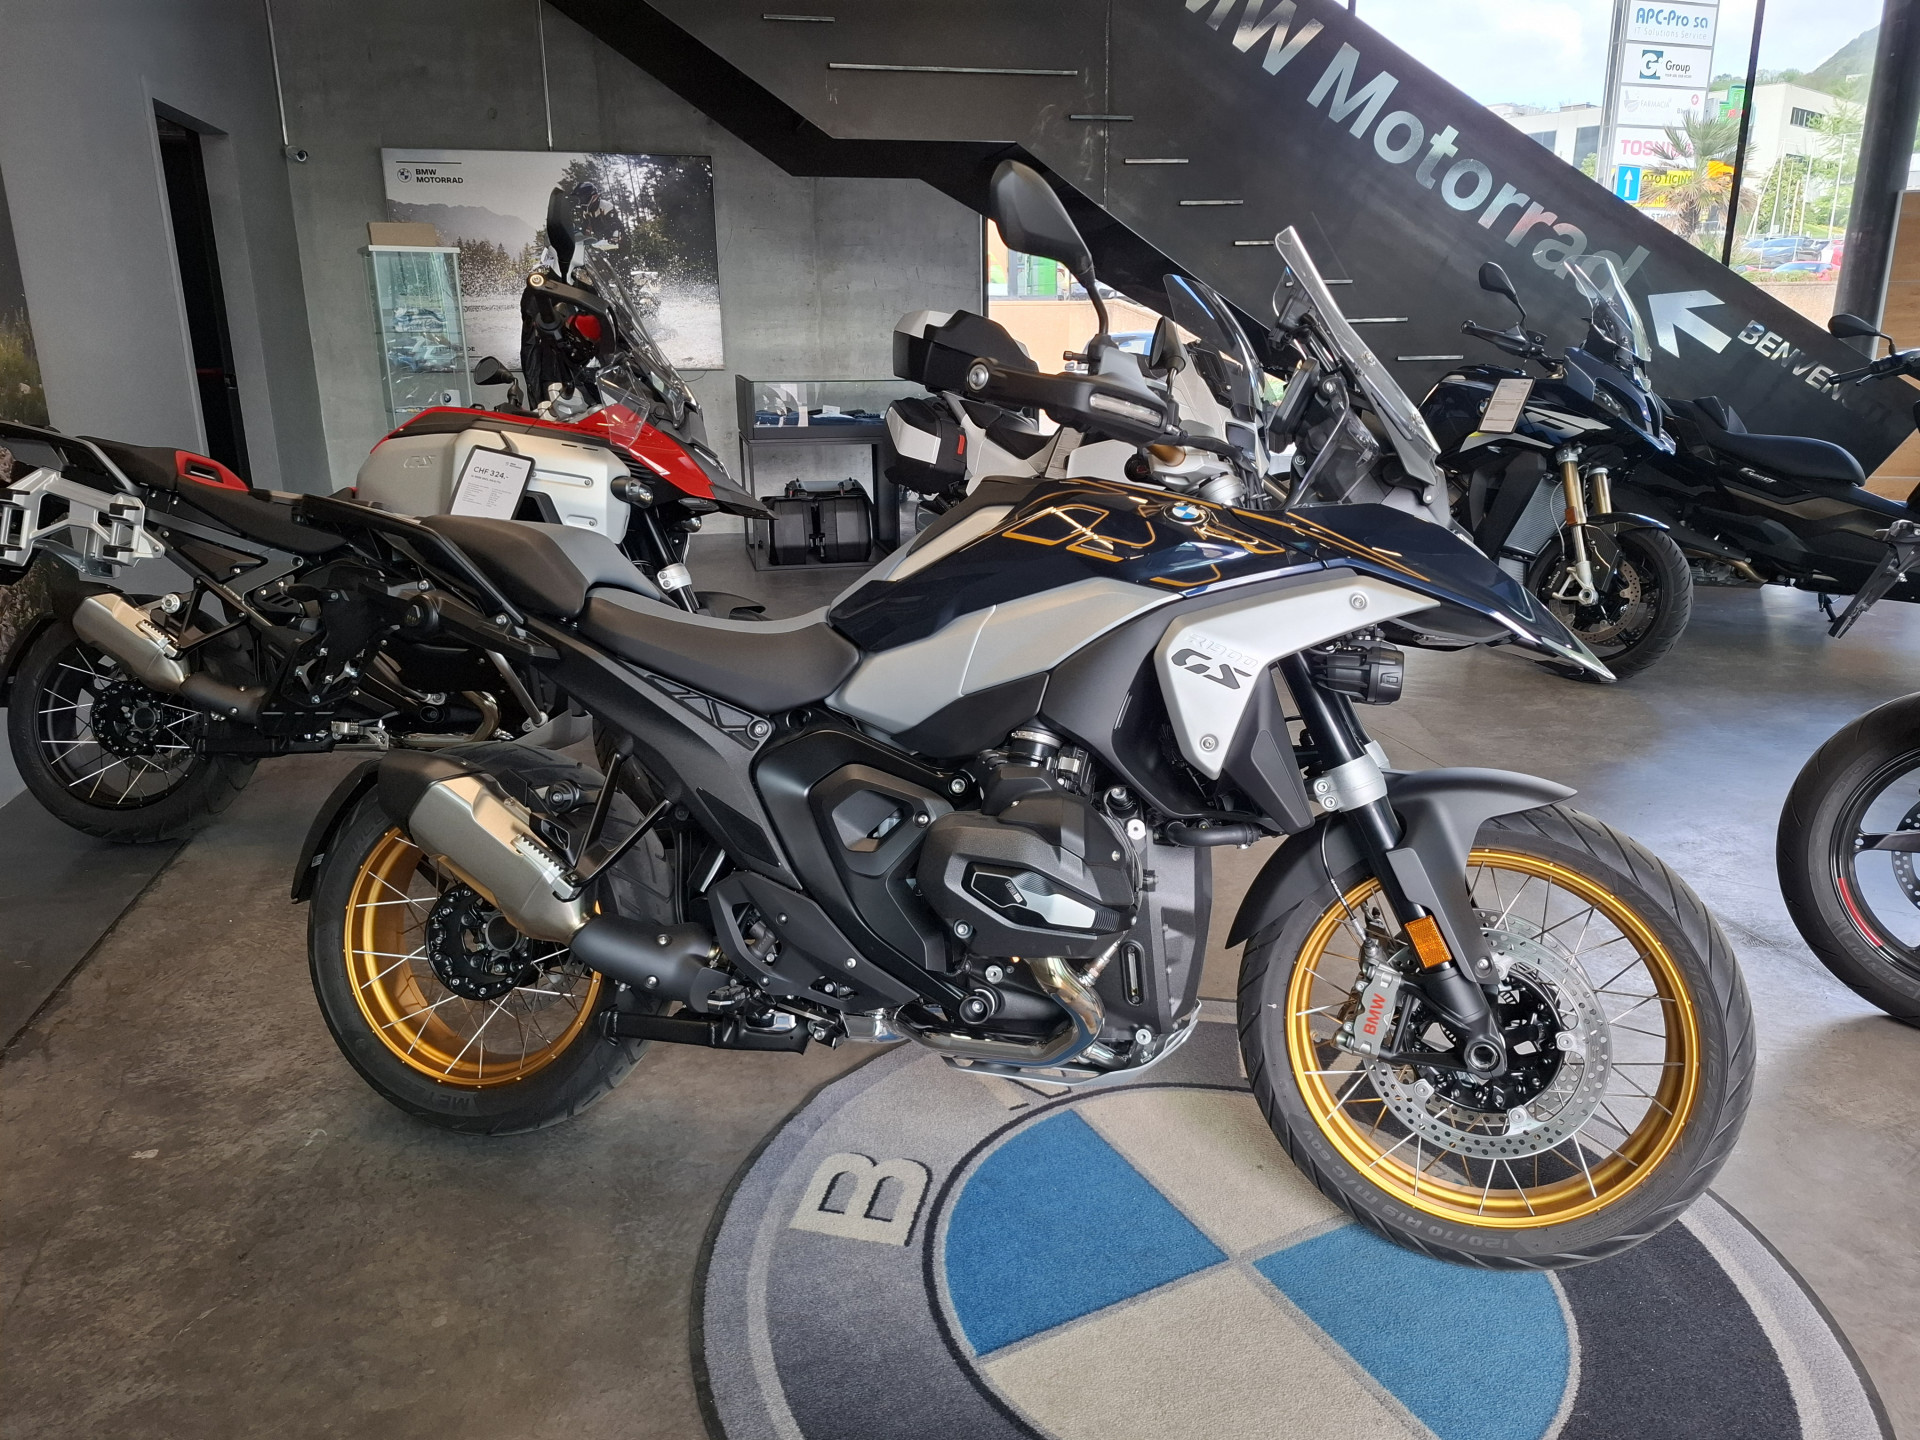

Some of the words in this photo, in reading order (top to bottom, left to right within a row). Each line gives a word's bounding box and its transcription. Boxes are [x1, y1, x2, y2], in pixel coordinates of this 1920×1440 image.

[1635, 8, 1689, 26] APC-Pro
[1665, 60, 1691, 74] Group
[416, 176, 464, 184] MOTORRAD
[1307, 42, 1650, 302] Motorrad
[473, 466, 489, 475] CHF
[1171, 648, 1252, 690] GS
[1363, 993, 1386, 1035] BMW
